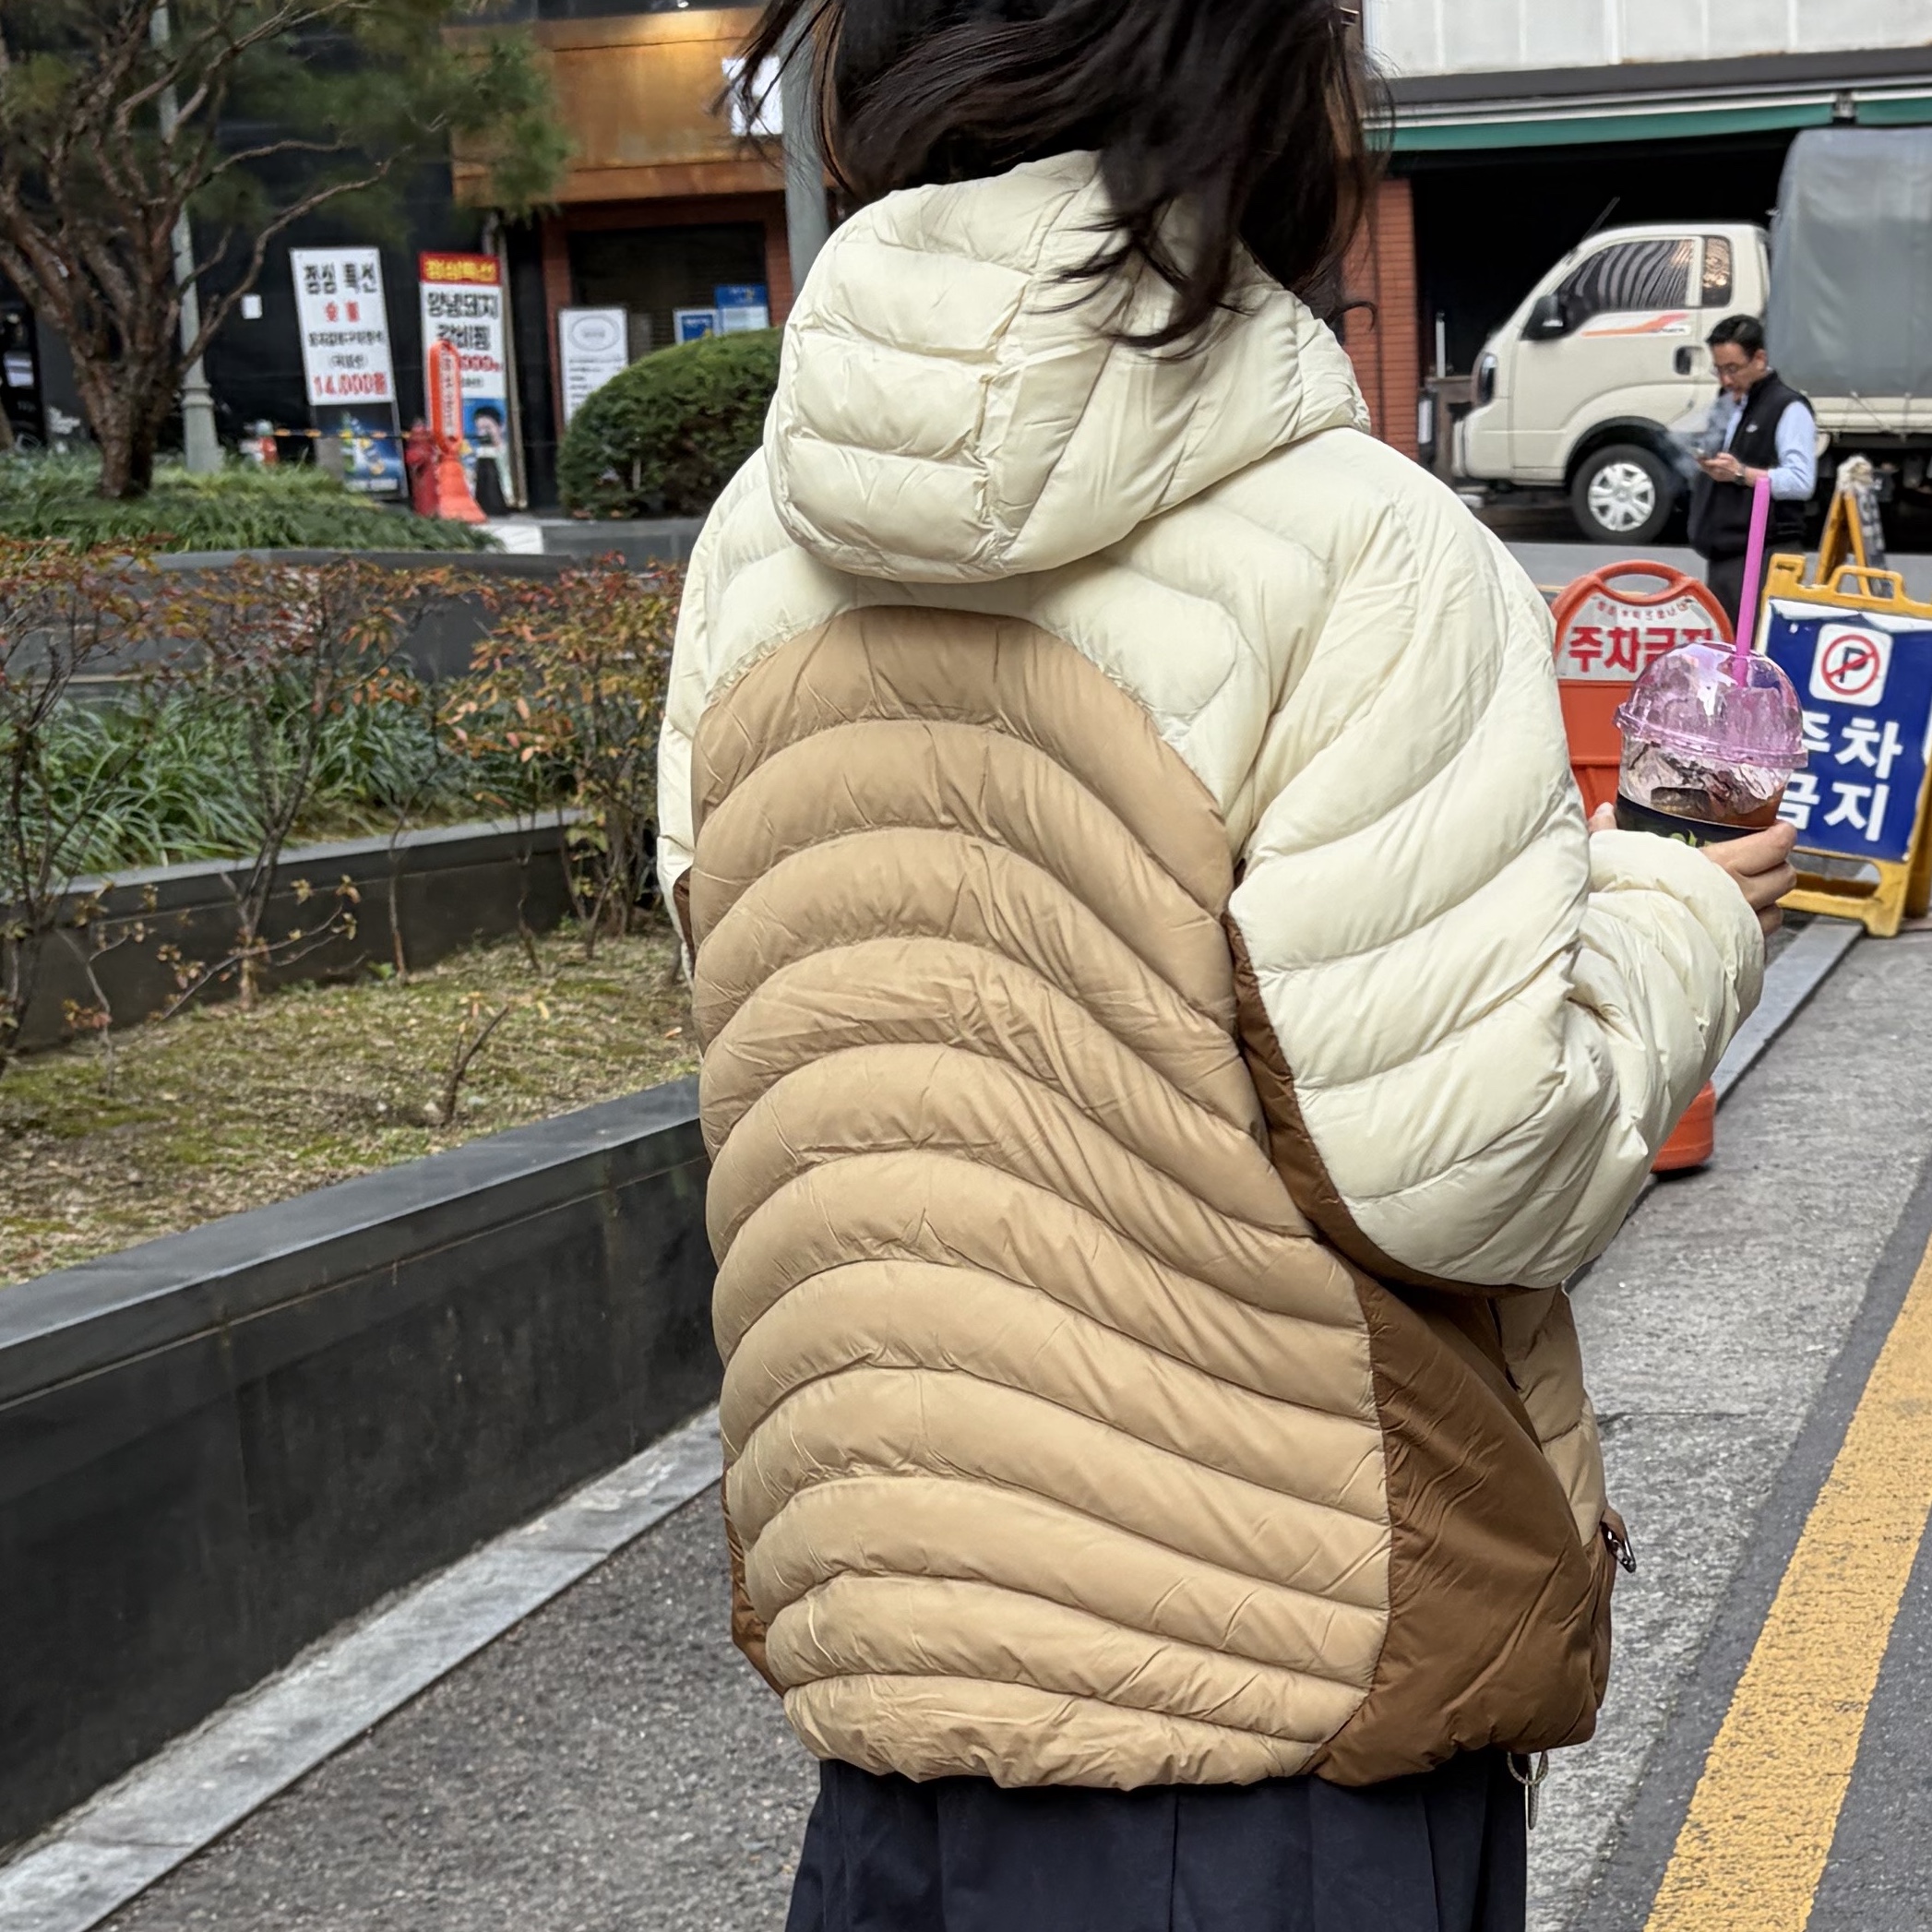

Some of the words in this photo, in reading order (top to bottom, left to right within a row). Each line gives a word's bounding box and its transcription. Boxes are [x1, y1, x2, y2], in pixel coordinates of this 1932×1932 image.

[302, 263, 337, 294] 점심
[343, 262, 377, 294] 특선
[1776, 772, 1890, 842] 금지
